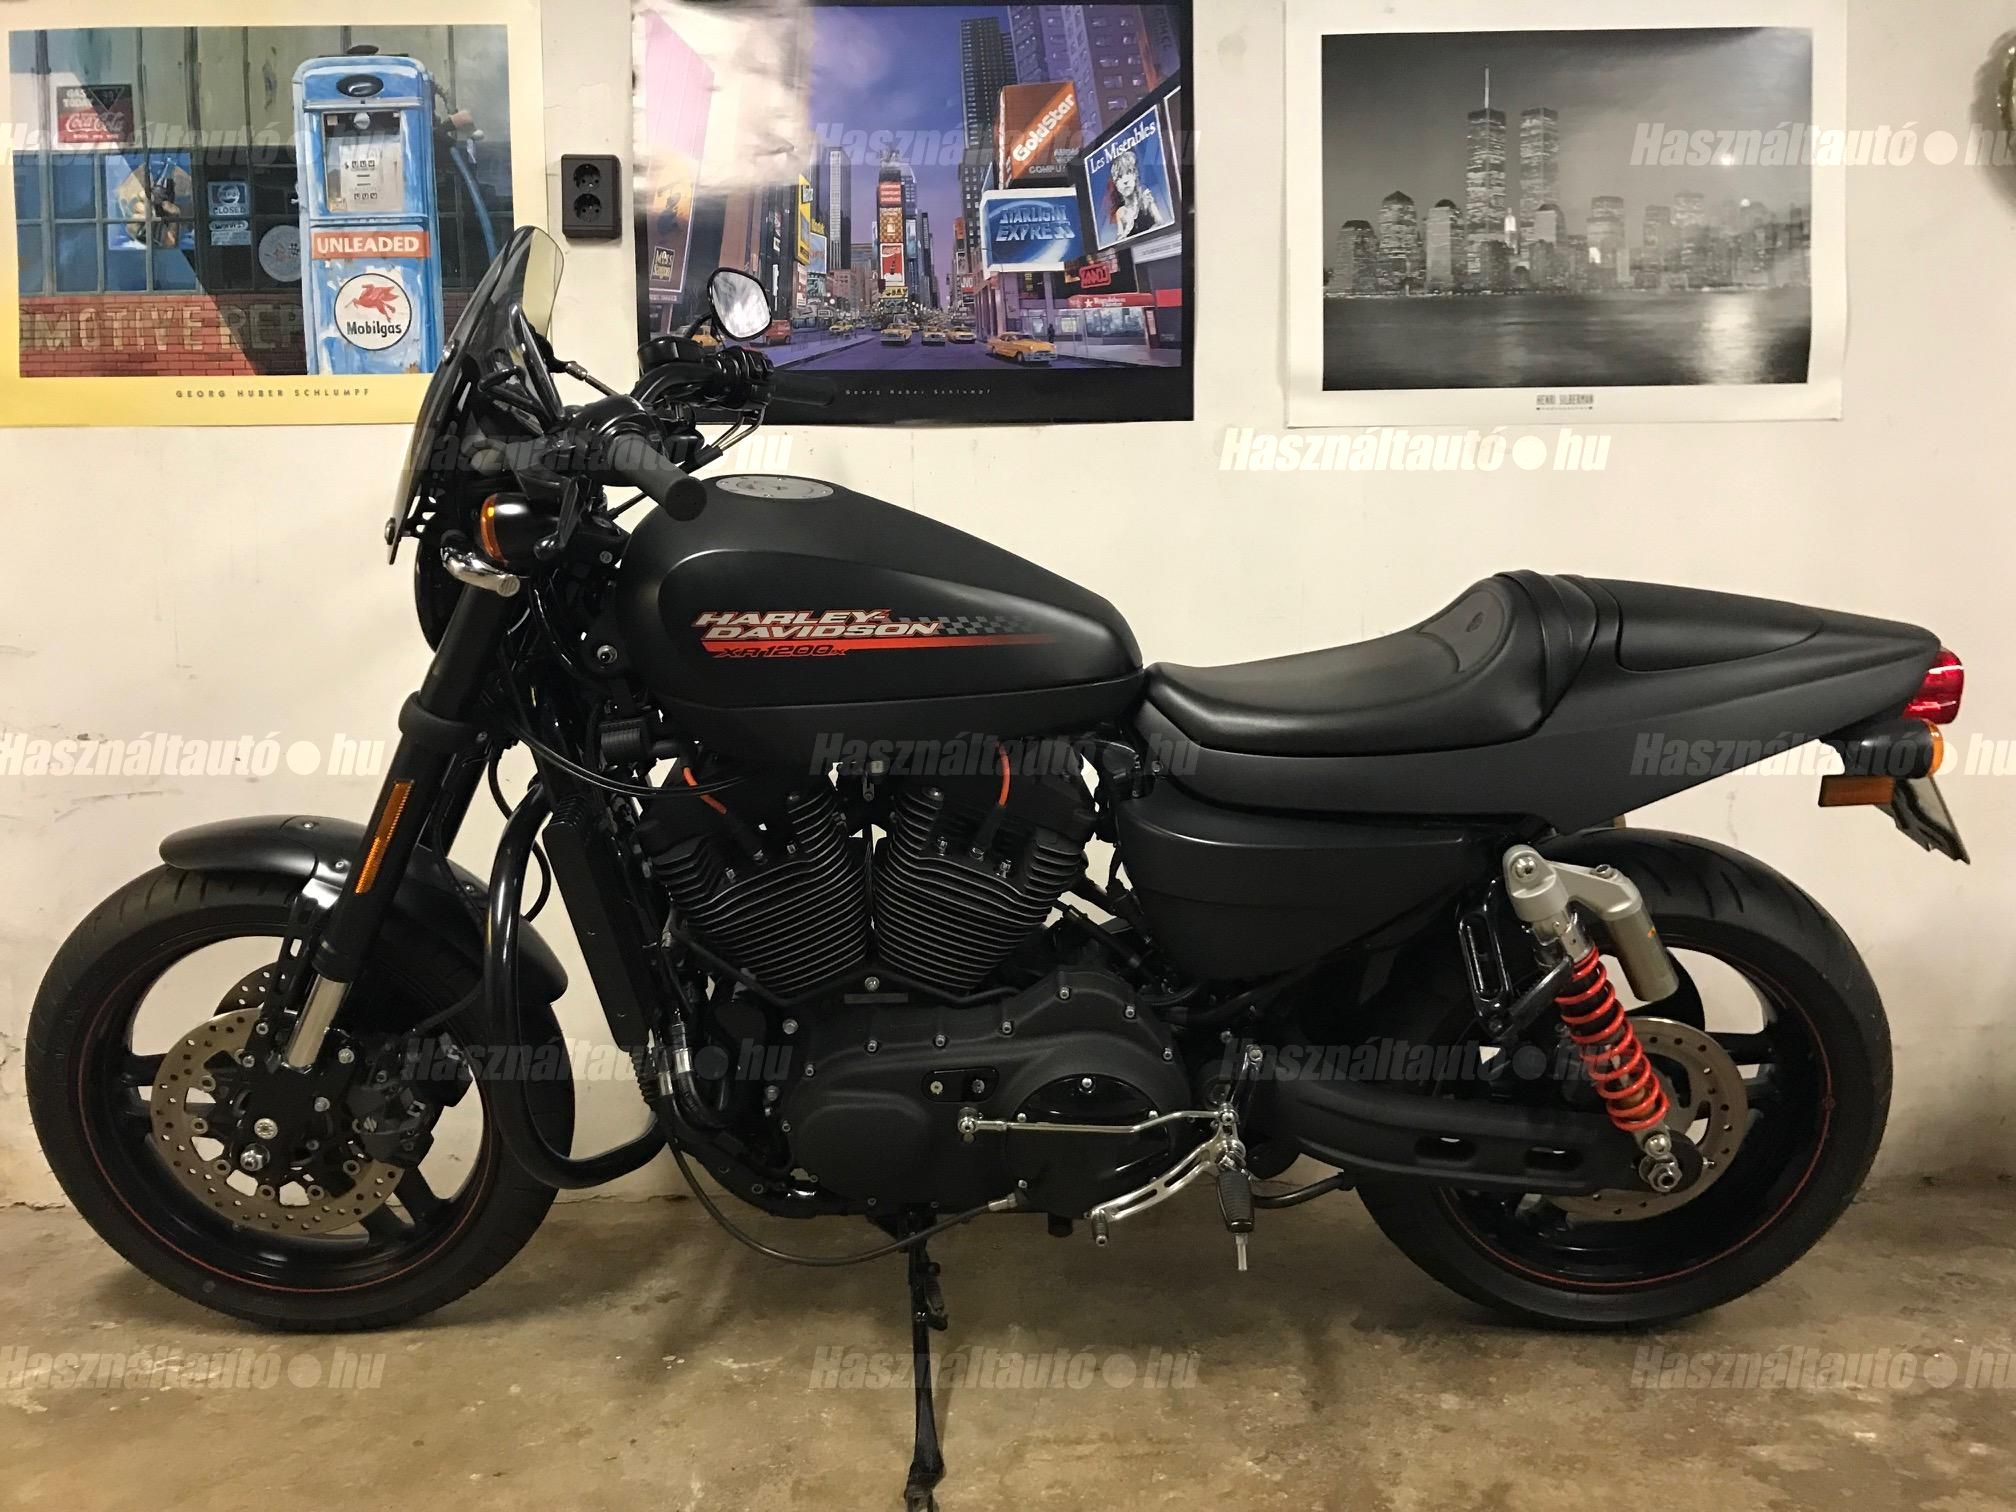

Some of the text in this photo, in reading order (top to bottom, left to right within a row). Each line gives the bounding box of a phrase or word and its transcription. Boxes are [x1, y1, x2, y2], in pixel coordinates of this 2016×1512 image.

[1012, 93, 1075, 162] GoldStar
[1090, 157, 1105, 174] Les
[996, 221, 1076, 242] EXPRESS
[317, 237, 420, 254] UNLEADED
[346, 321, 402, 337] Mobilgas
[175, 388, 369, 398] GEORG HUBER SCHLUMPF
[705, 622, 938, 639] DAVIDSON
